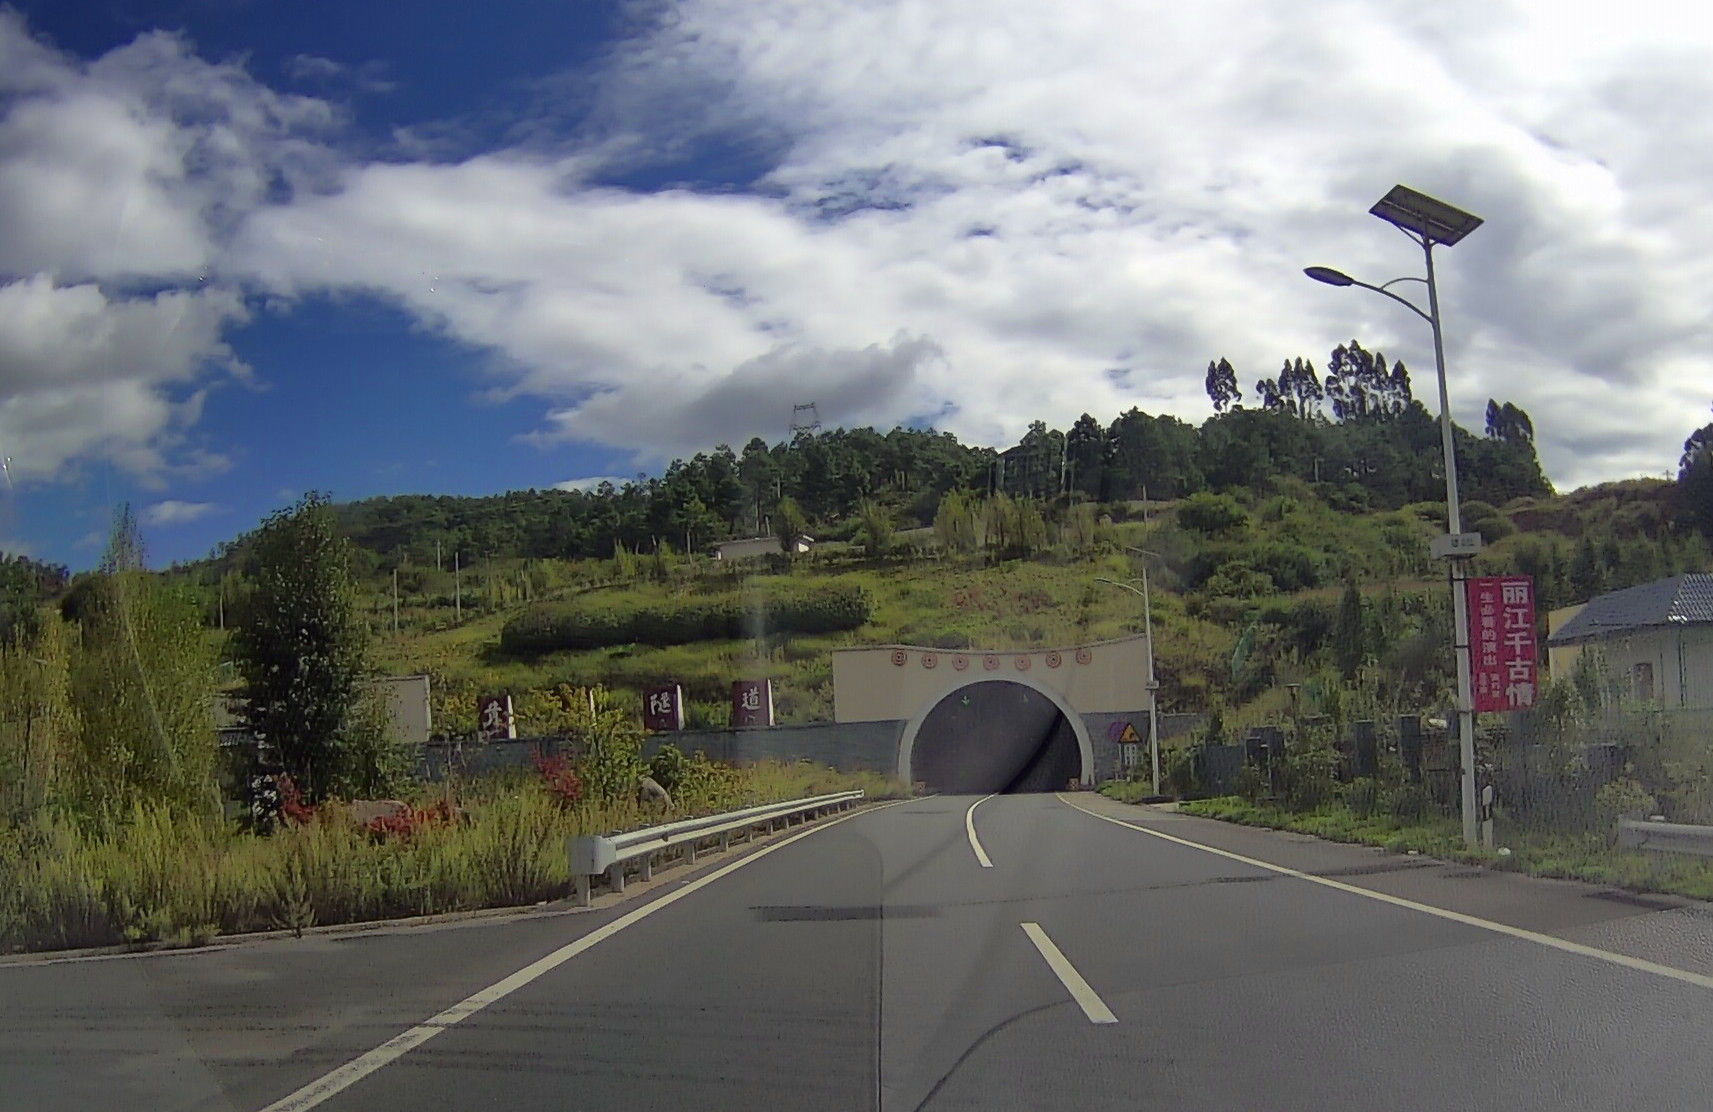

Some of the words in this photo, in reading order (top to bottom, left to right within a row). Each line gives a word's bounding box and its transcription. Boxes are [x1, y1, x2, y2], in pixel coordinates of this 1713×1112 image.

[1501, 582, 1533, 706] 丽江千古情
